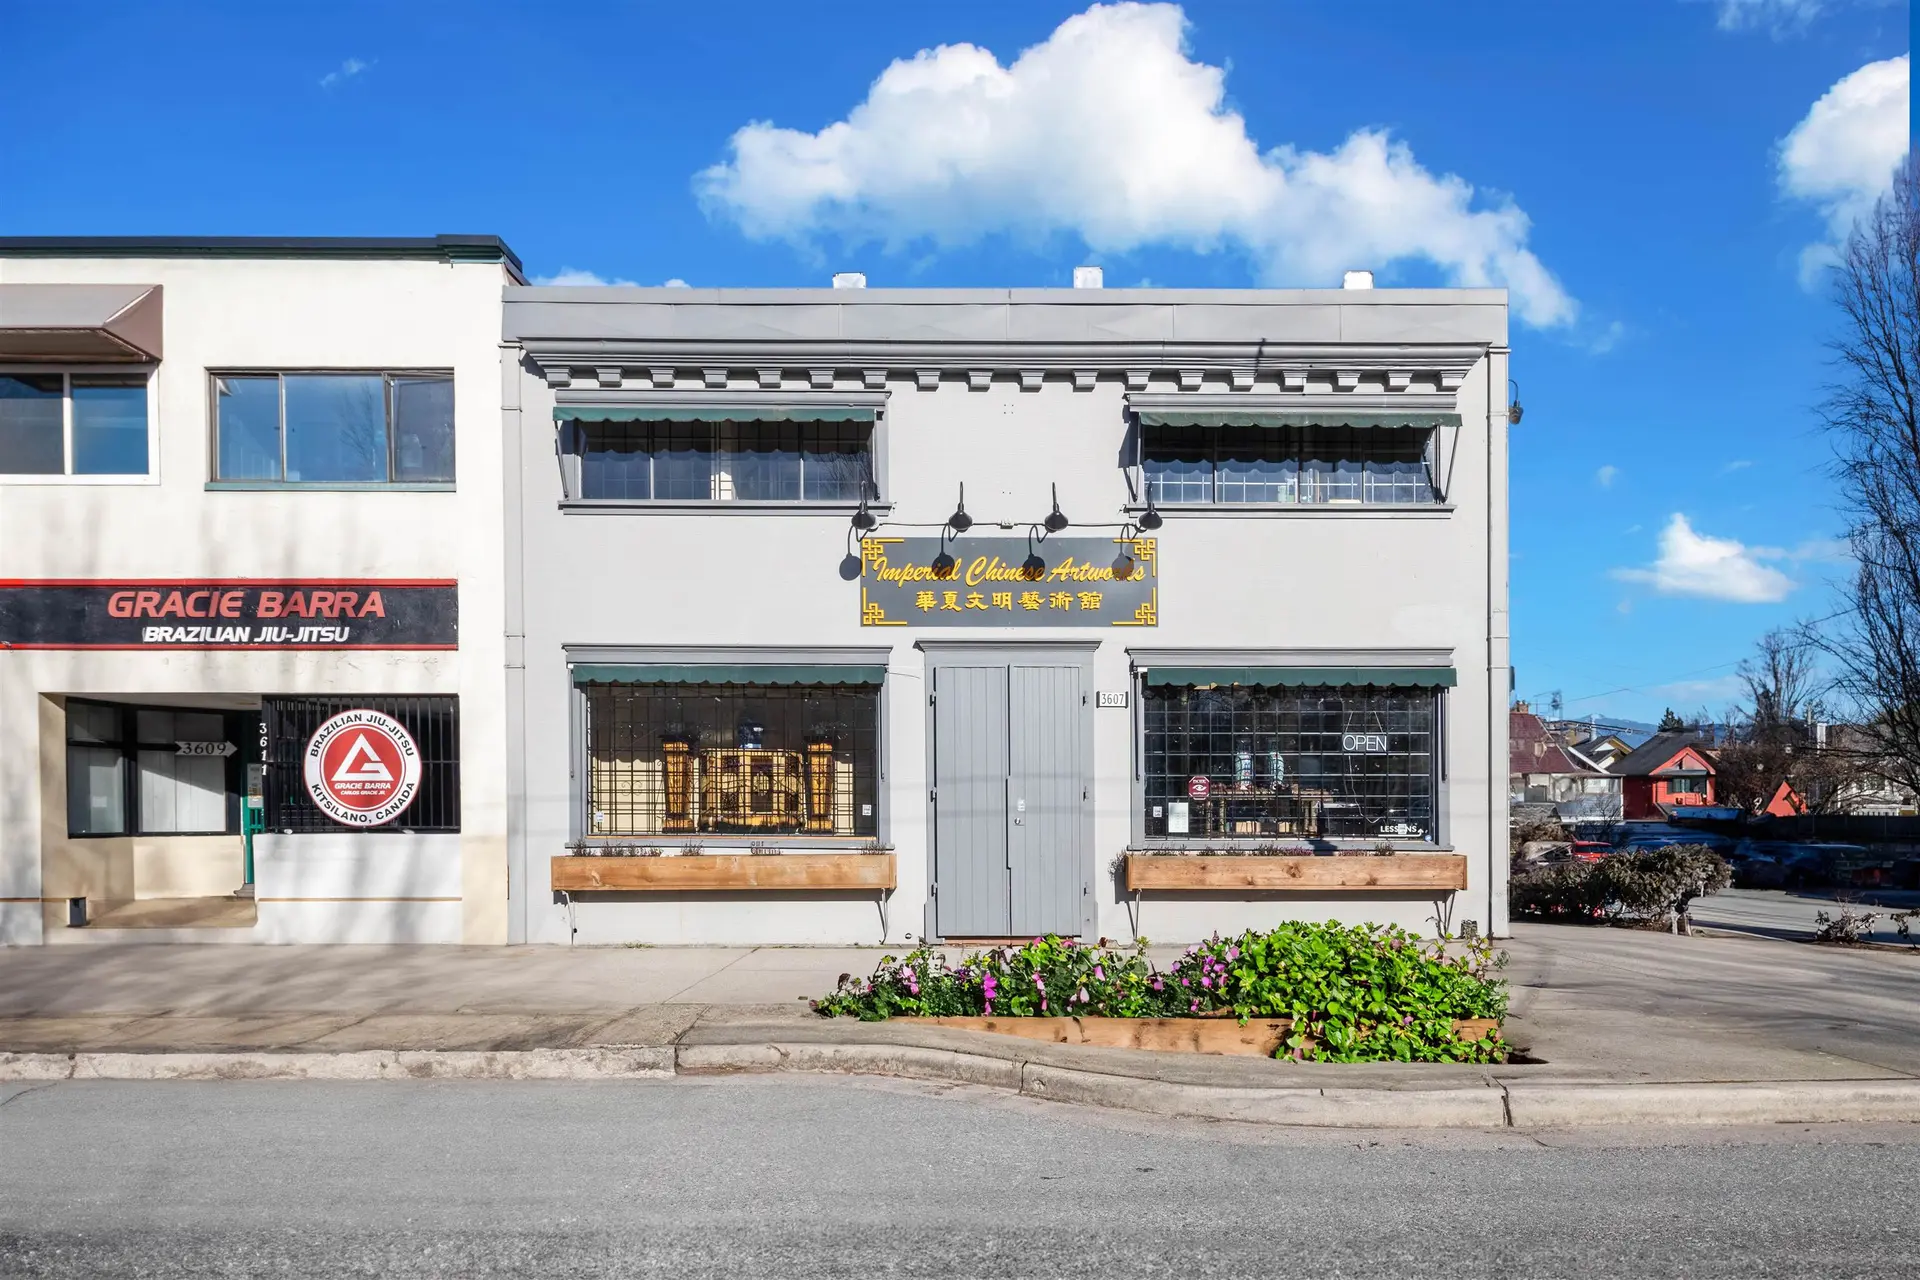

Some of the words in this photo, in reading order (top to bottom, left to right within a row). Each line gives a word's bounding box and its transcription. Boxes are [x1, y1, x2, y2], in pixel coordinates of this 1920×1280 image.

[873, 556, 962, 588] Imperial
[965, 556, 1045, 587] Chinese
[1046, 557, 1146, 583] Artwos
[107, 591, 244, 618] GRACIE
[256, 591, 386, 618] BARRA
[143, 626, 250, 643] BRAZILIAN
[253, 626, 350, 643] JIU-JITSU
[1101, 693, 1125, 705] 3607
[310, 713, 362, 757] BRAZILIAN
[366, 714, 414, 757] JIU-JITSU
[1343, 734, 1387, 751] OPEN
[182, 742, 227, 755] 3609
[259, 722, 268, 776] 3611
[334, 782, 363, 790] GRACIE
[364, 782, 391, 790] BARRA
[311, 783, 372, 823] KITSILANO,
[375, 782, 415, 820] CANADA
[1380, 825, 1417, 833] LESSNS
